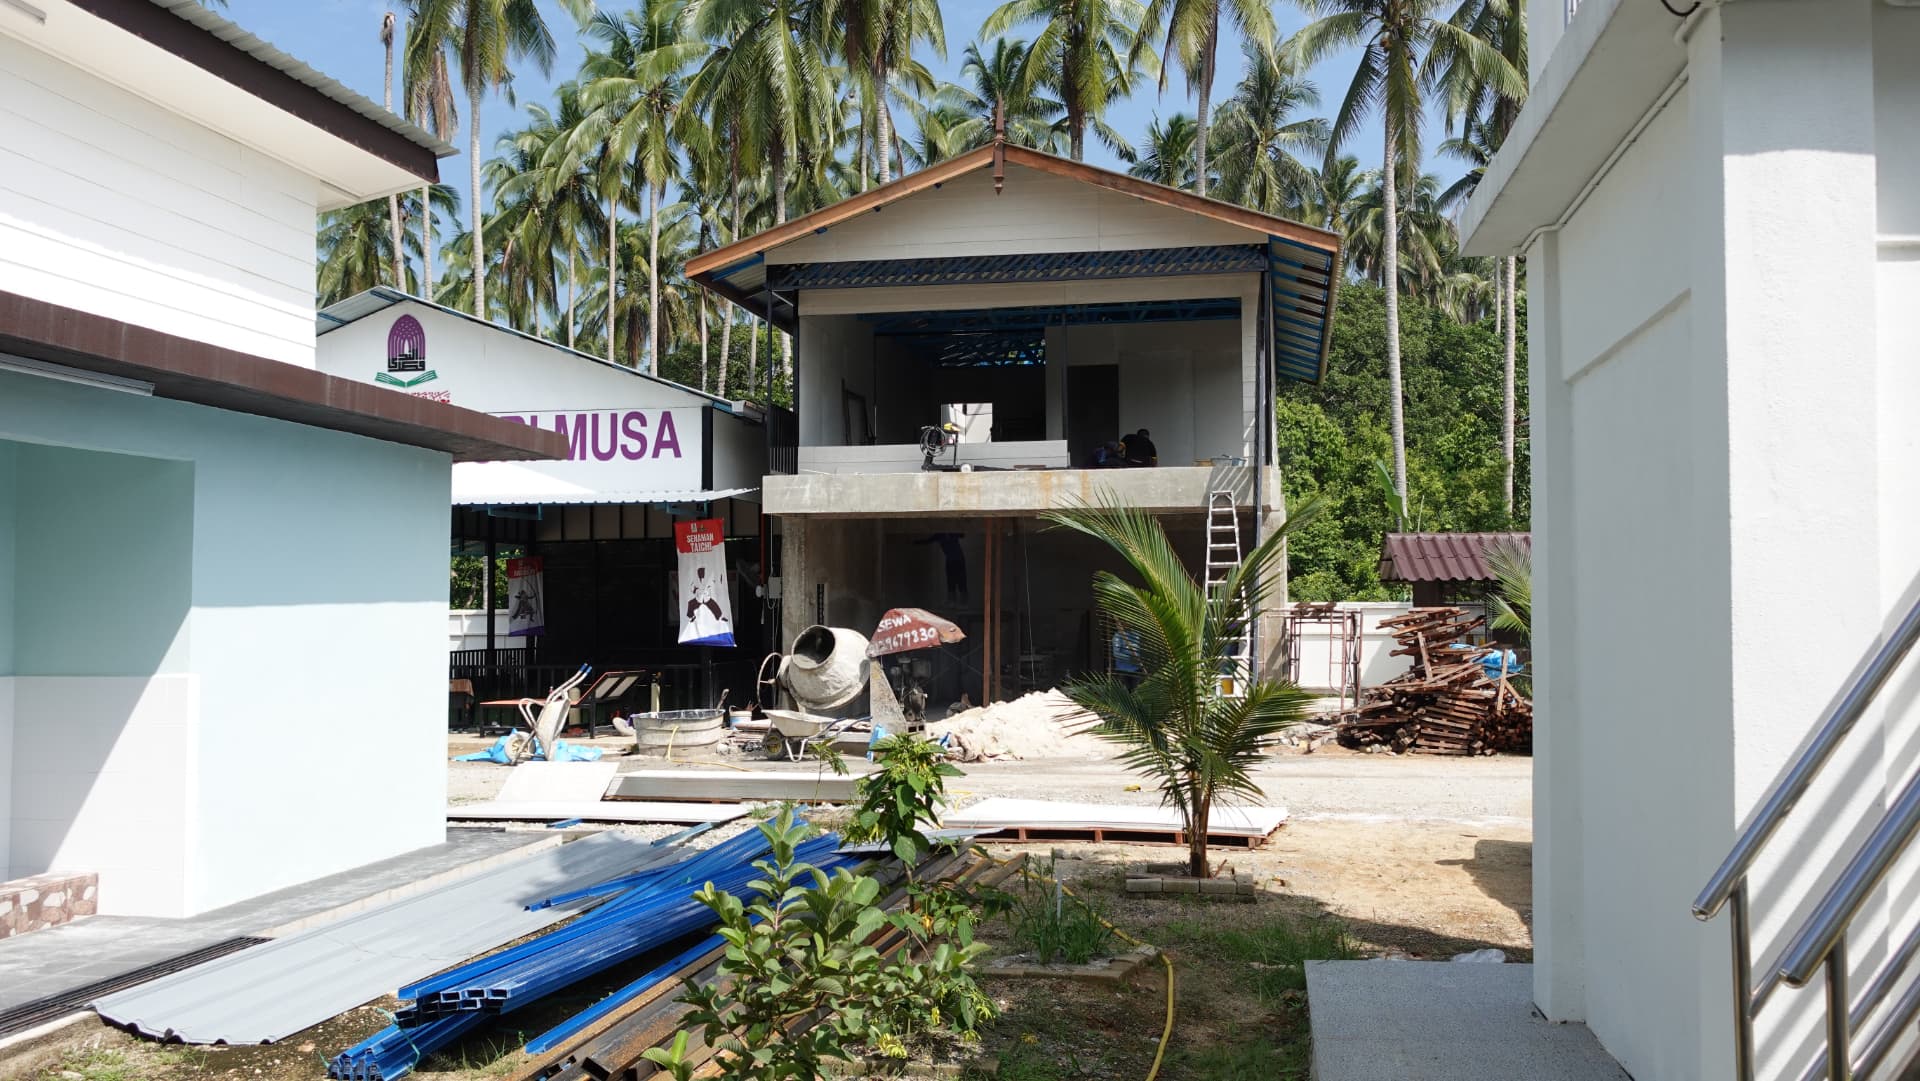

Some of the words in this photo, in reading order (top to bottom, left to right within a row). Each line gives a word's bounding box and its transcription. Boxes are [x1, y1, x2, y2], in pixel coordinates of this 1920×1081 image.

[555, 411, 682, 461] MUSA
[690, 542, 713, 553] TAICHI
[877, 614, 912, 633] SEWA
